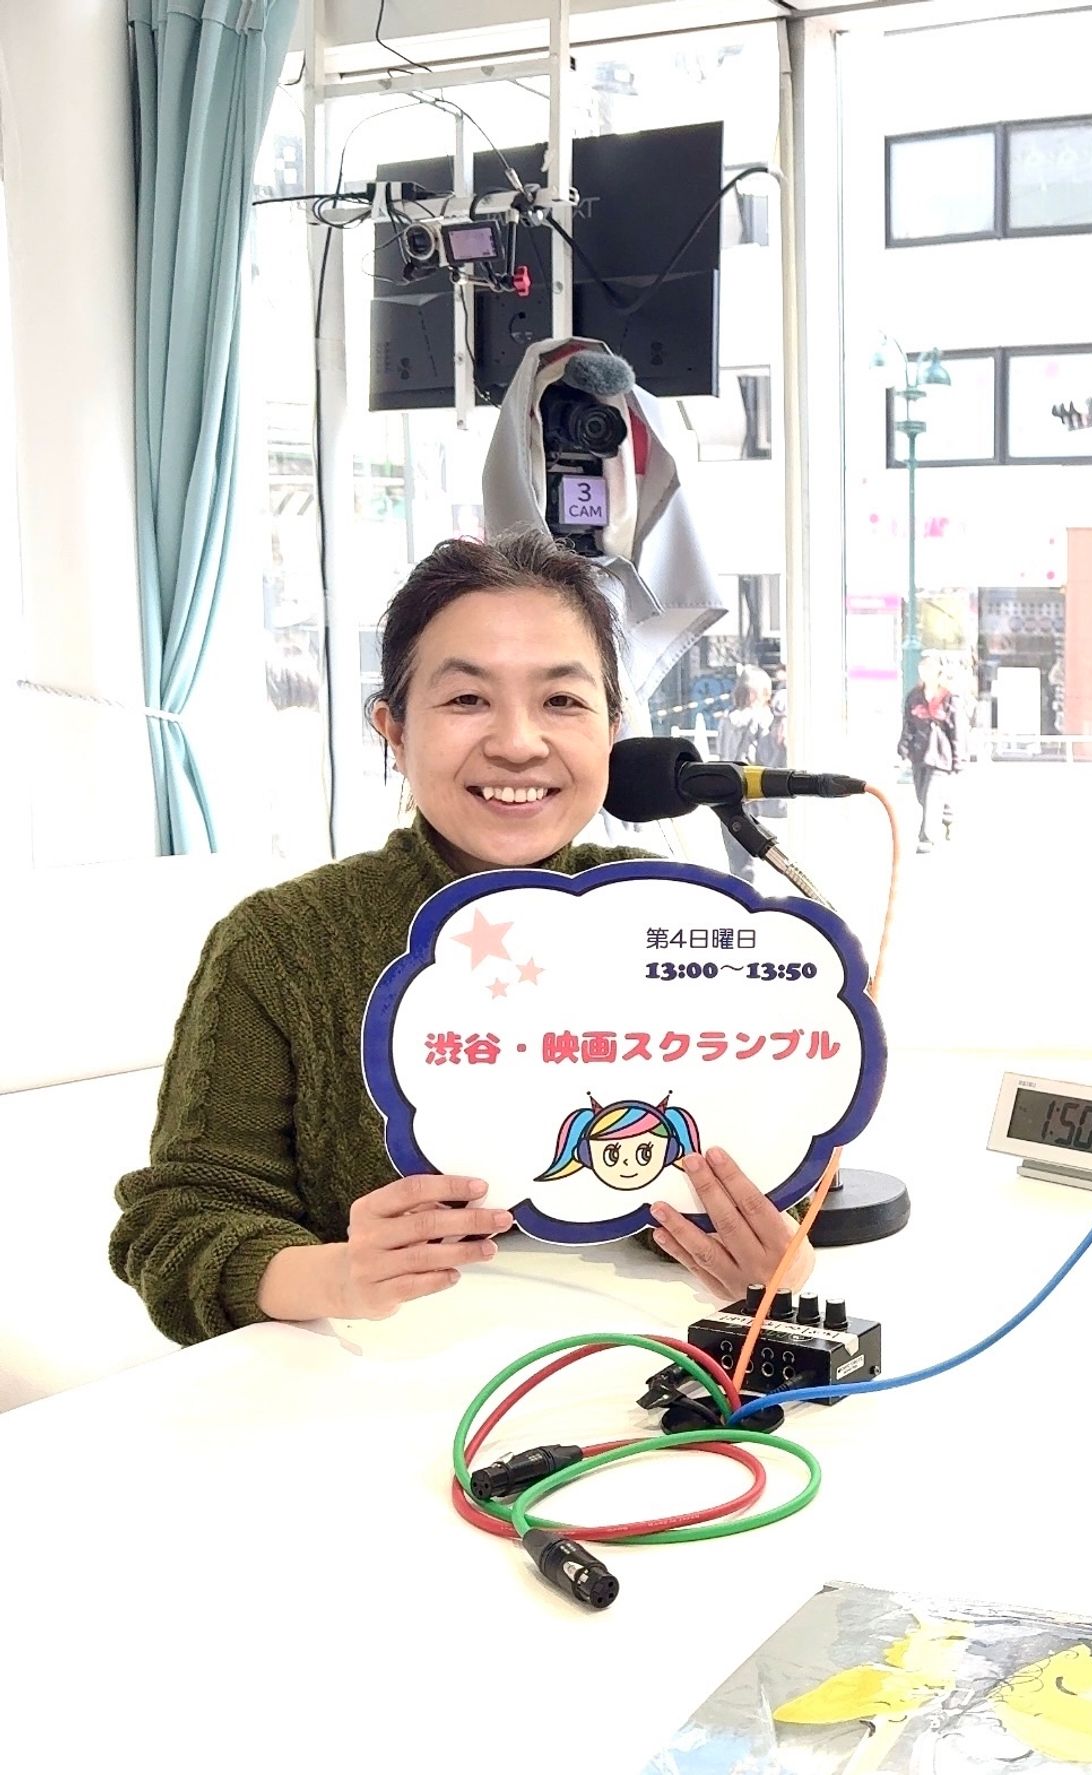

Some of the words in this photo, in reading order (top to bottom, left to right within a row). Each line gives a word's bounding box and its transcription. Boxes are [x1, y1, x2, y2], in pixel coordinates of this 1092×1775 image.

[577, 482, 591, 502] 3
[568, 504, 602, 518] CAM
[646, 927, 756, 950] 第4日曜日
[424, 1029, 841, 1065] 渋谷・映画スクランブル
